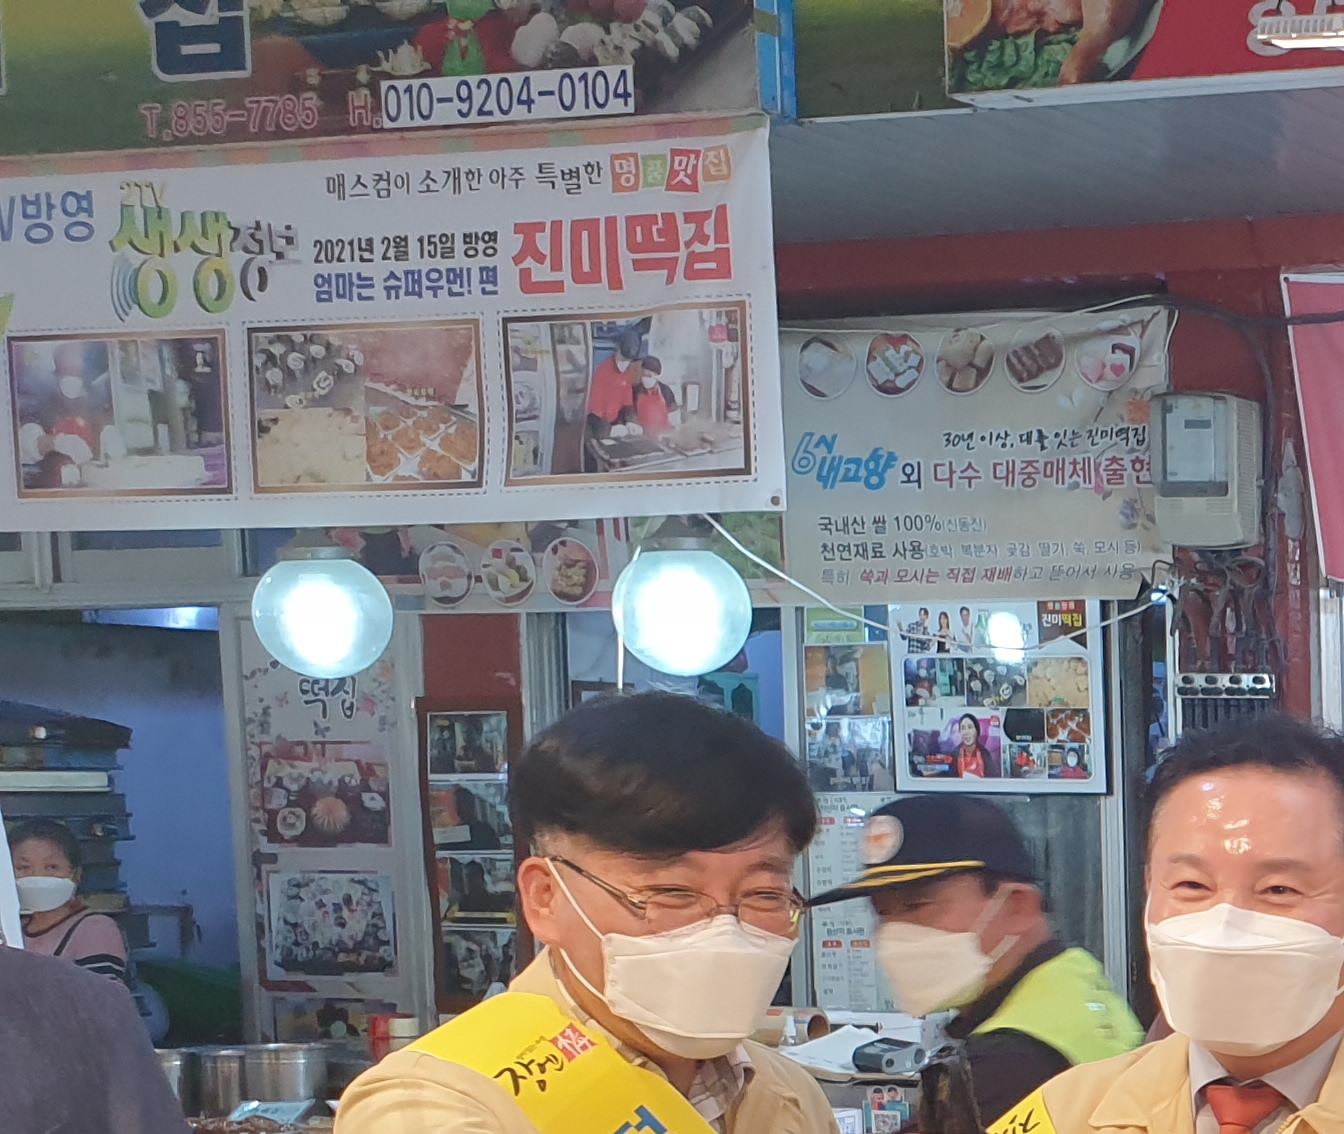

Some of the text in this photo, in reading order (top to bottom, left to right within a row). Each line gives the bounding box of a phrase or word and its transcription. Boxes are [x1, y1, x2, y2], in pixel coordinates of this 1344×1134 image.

[416, 166, 484, 195] 소개한
[488, 164, 527, 190] 아주
[534, 160, 604, 196] 특별한
[312, 204, 733, 295] 2021년 2월 15일 방영 진미떡집
[312, 264, 500, 303] 엄마는 슈퍼우먼! 편
[942, 431, 976, 451] 30년
[900, 460, 922, 490] 외
[932, 460, 983, 490] 다수
[992, 456, 1094, 490] 대중매체
[817, 515, 867, 535] 국내산
[820, 541, 888, 562] 천연재료
